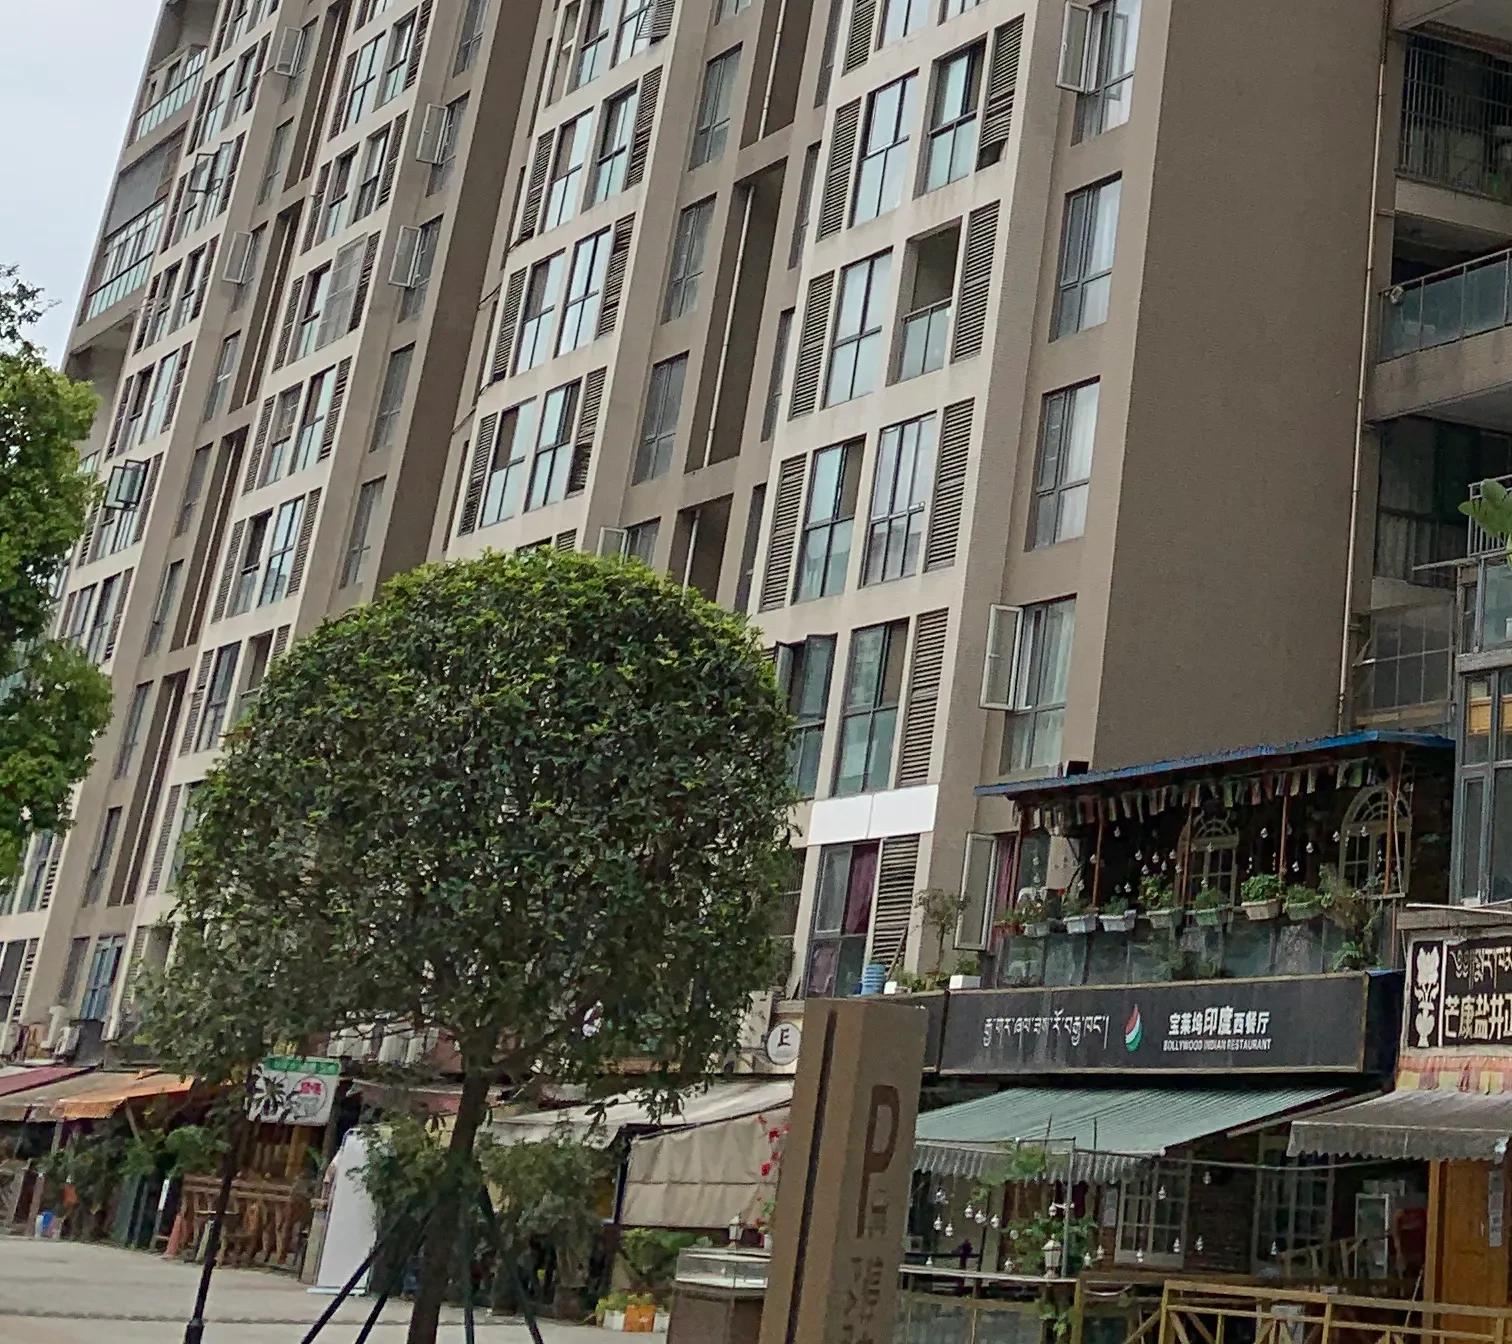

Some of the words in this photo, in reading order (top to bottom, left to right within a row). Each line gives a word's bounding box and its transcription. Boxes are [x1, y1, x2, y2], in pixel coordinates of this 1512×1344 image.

[1168, 1005, 1270, 1035] 宝莱坞印度西餐厅
[857, 1084, 899, 1238] P
